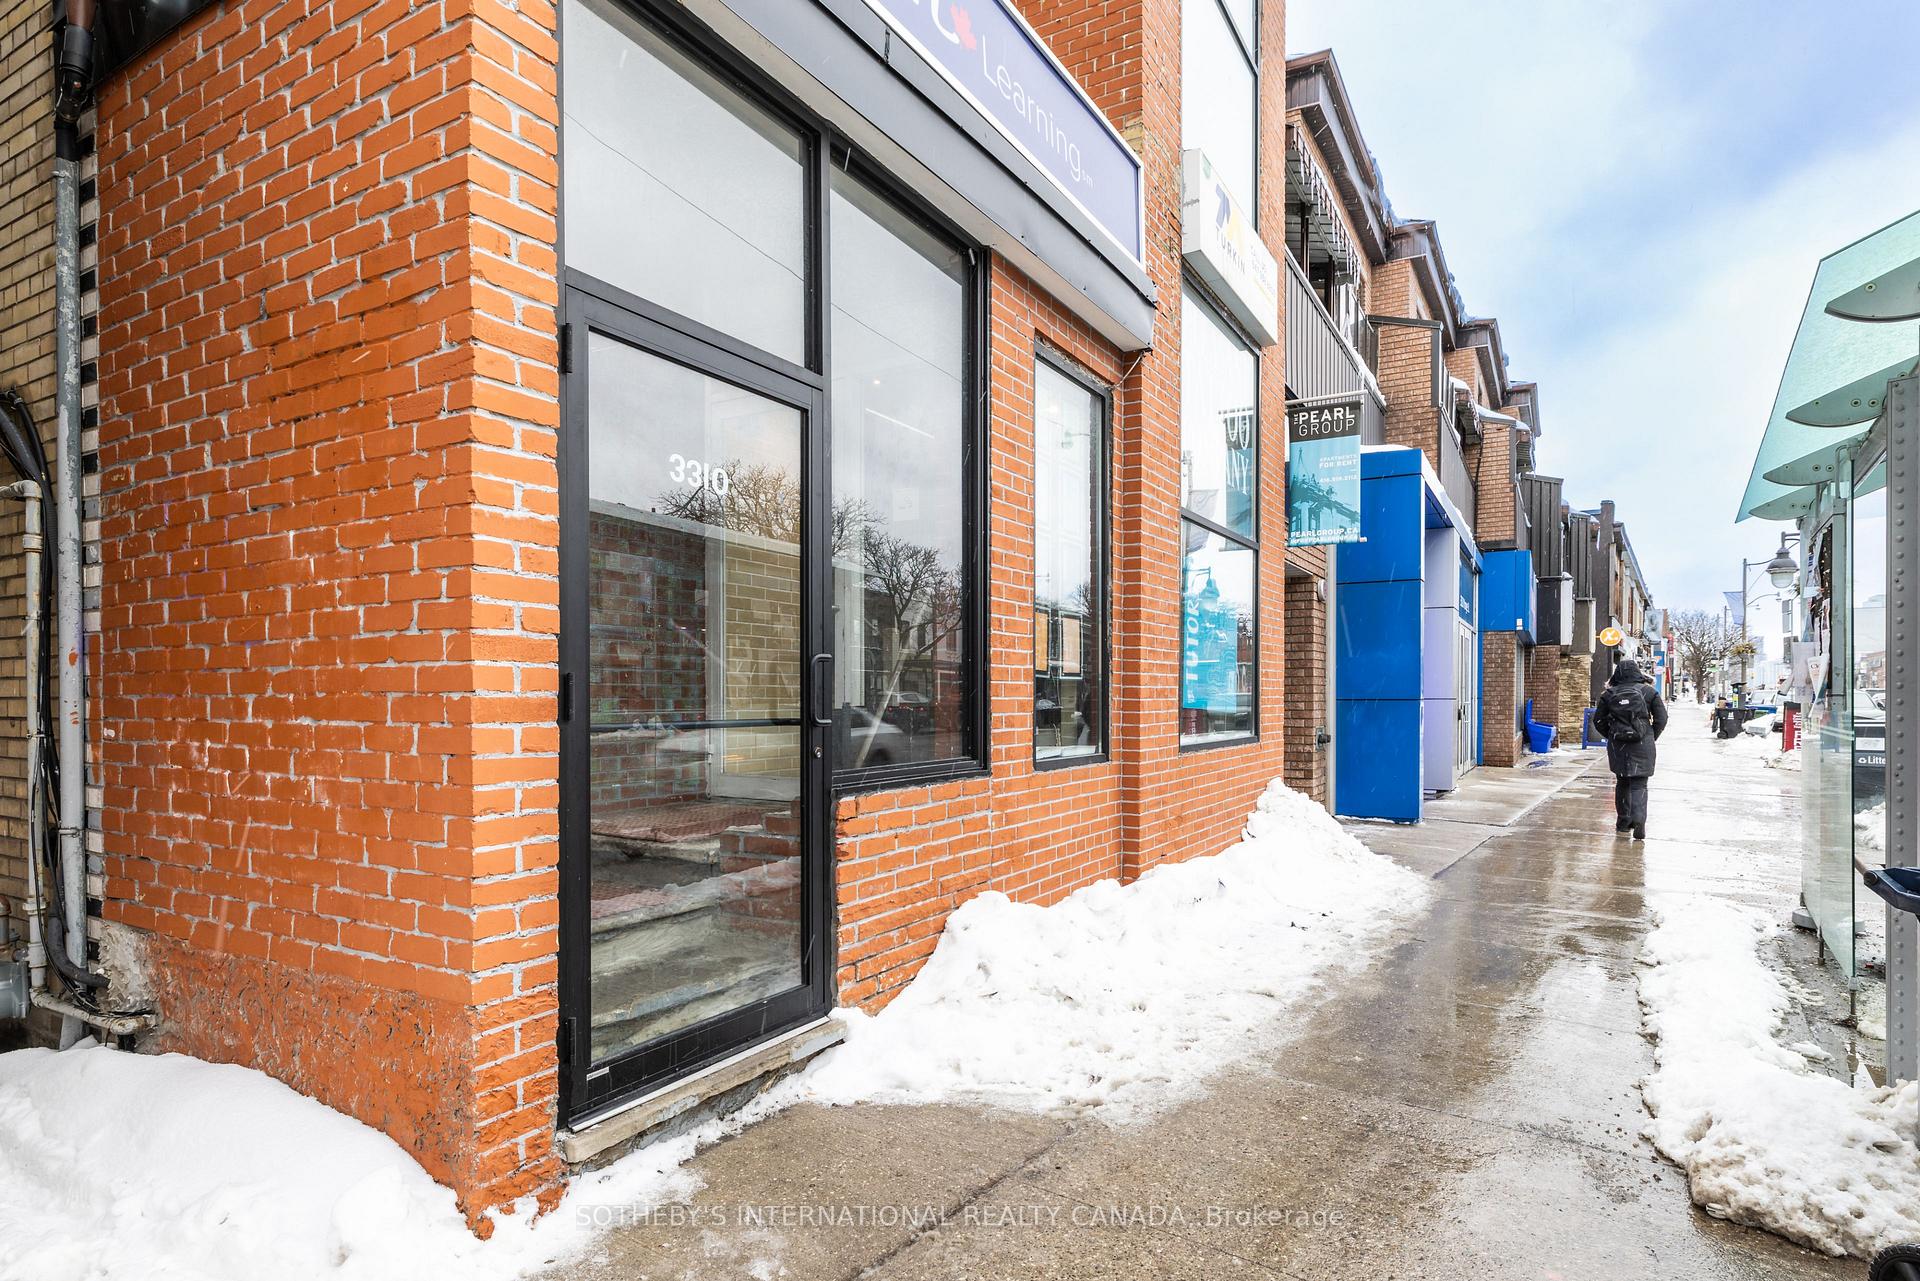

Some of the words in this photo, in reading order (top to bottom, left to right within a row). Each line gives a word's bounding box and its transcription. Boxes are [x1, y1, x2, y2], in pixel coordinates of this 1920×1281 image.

[982, 34, 1081, 182] Learning
[1215, 226, 1246, 275] TURKIN
[1298, 406, 1356, 425] PEARL
[1298, 418, 1355, 437] GROUP
[669, 453, 729, 497] 3310
[1185, 597, 1200, 686] TUTOR
